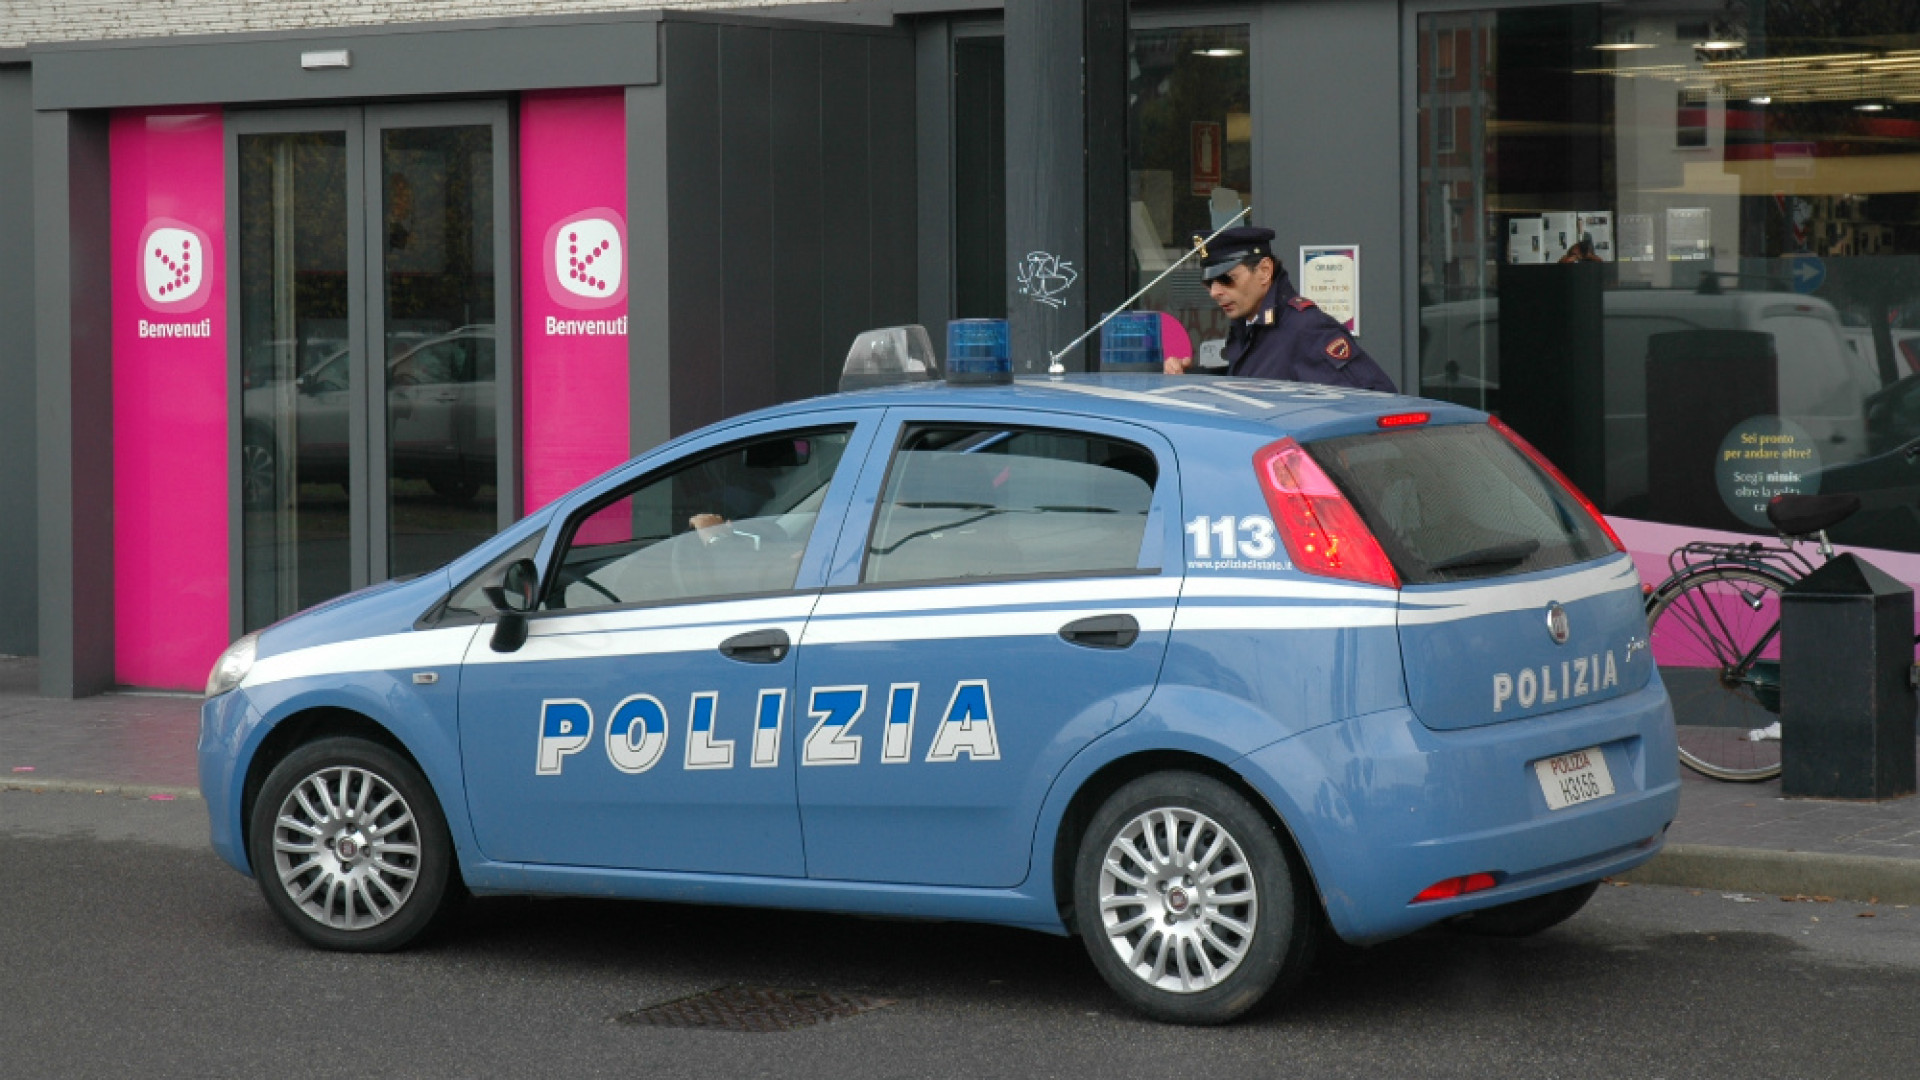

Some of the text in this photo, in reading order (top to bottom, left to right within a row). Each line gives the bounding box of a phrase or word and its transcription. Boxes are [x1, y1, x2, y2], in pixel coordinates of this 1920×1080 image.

[138, 318, 211, 338] Benvenuti
[546, 315, 628, 335] Benvenuti
[1741, 433, 1794, 446] Sei pronto
[1724, 448, 1812, 461] per andare oltre?
[1733, 472, 1763, 485] Scegli
[1735, 486, 1760, 497] oltre
[1762, 486, 1771, 497] la
[1185, 514, 1276, 559] 113
[1492, 650, 1618, 713] POLIZIA
[535, 678, 1002, 776] POLIZIA
[1550, 752, 1592, 775] POLIZIA
[1559, 772, 1600, 804] H3156
